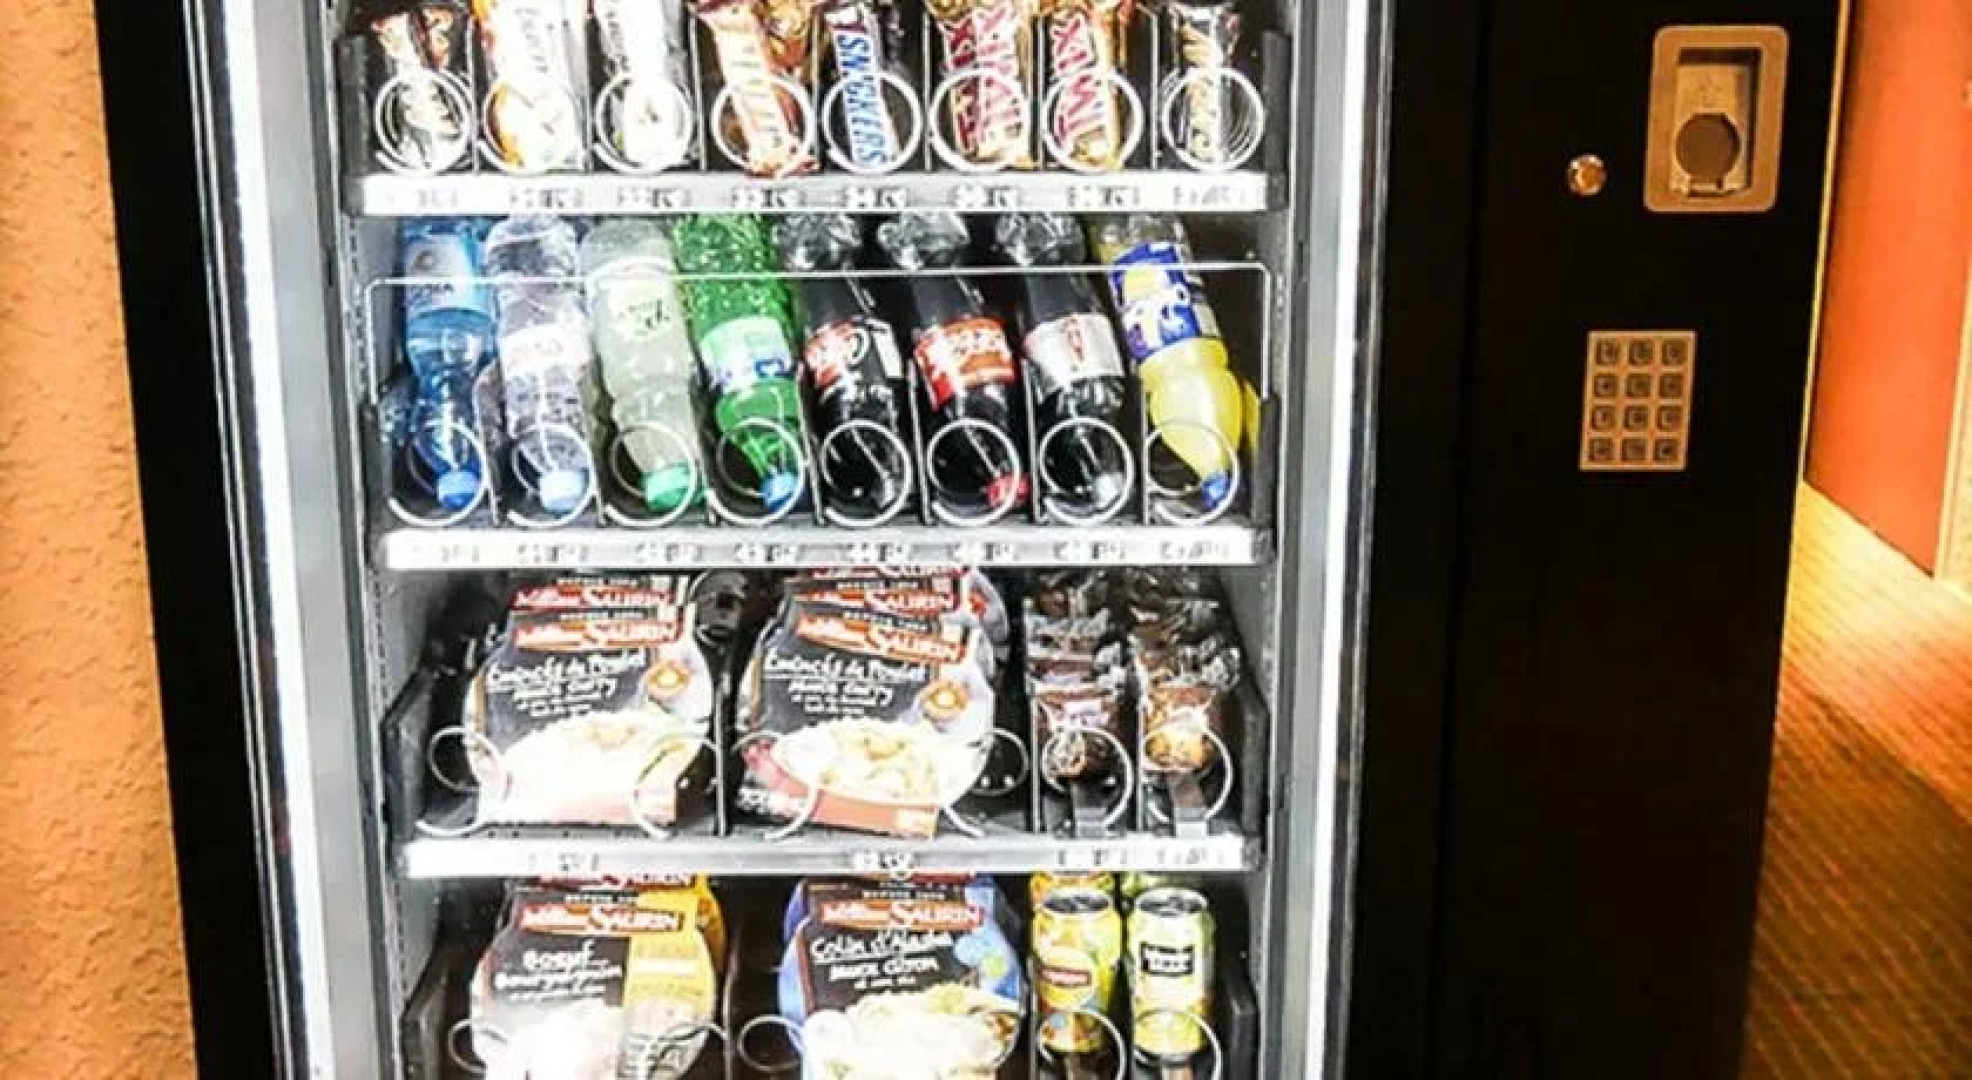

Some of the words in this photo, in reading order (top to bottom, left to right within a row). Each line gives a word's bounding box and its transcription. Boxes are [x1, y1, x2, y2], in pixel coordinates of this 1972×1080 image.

[1053, 15, 1106, 148] TWIX
[838, 34, 887, 165] SNCKERS
[581, 586, 674, 608] SAURIN
[865, 587, 955, 614] SAURIN
[581, 620, 677, 649] SAURIN
[868, 622, 963, 663] SAURIN
[588, 902, 680, 931] SAURIN
[890, 900, 980, 929] SAURIN
